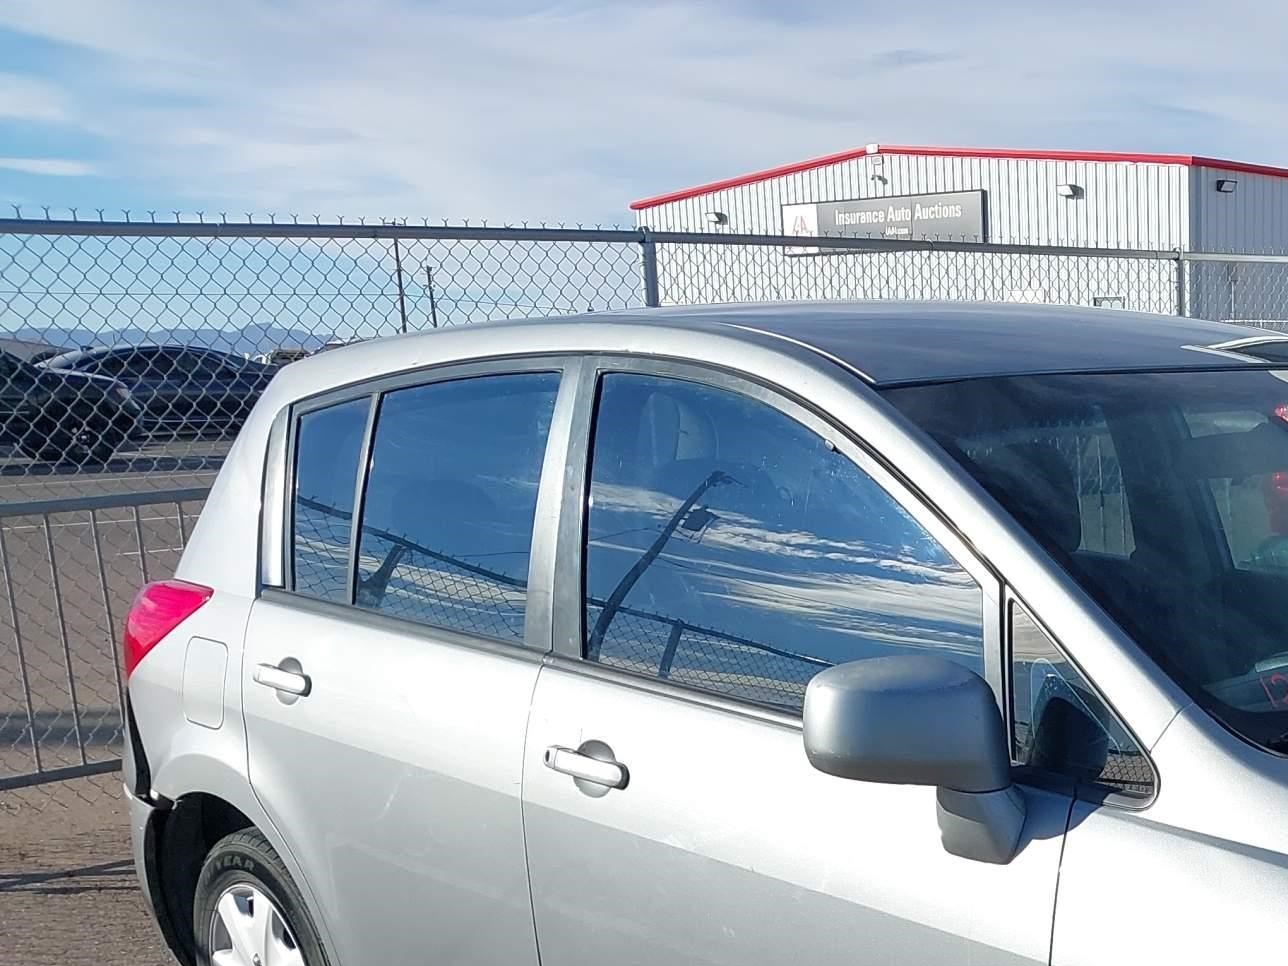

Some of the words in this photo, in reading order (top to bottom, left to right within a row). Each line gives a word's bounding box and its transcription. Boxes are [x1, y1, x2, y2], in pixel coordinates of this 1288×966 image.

[835, 207, 885, 226] Insurance
[886, 204, 912, 222] Auto
[914, 201, 962, 220] Auctions
